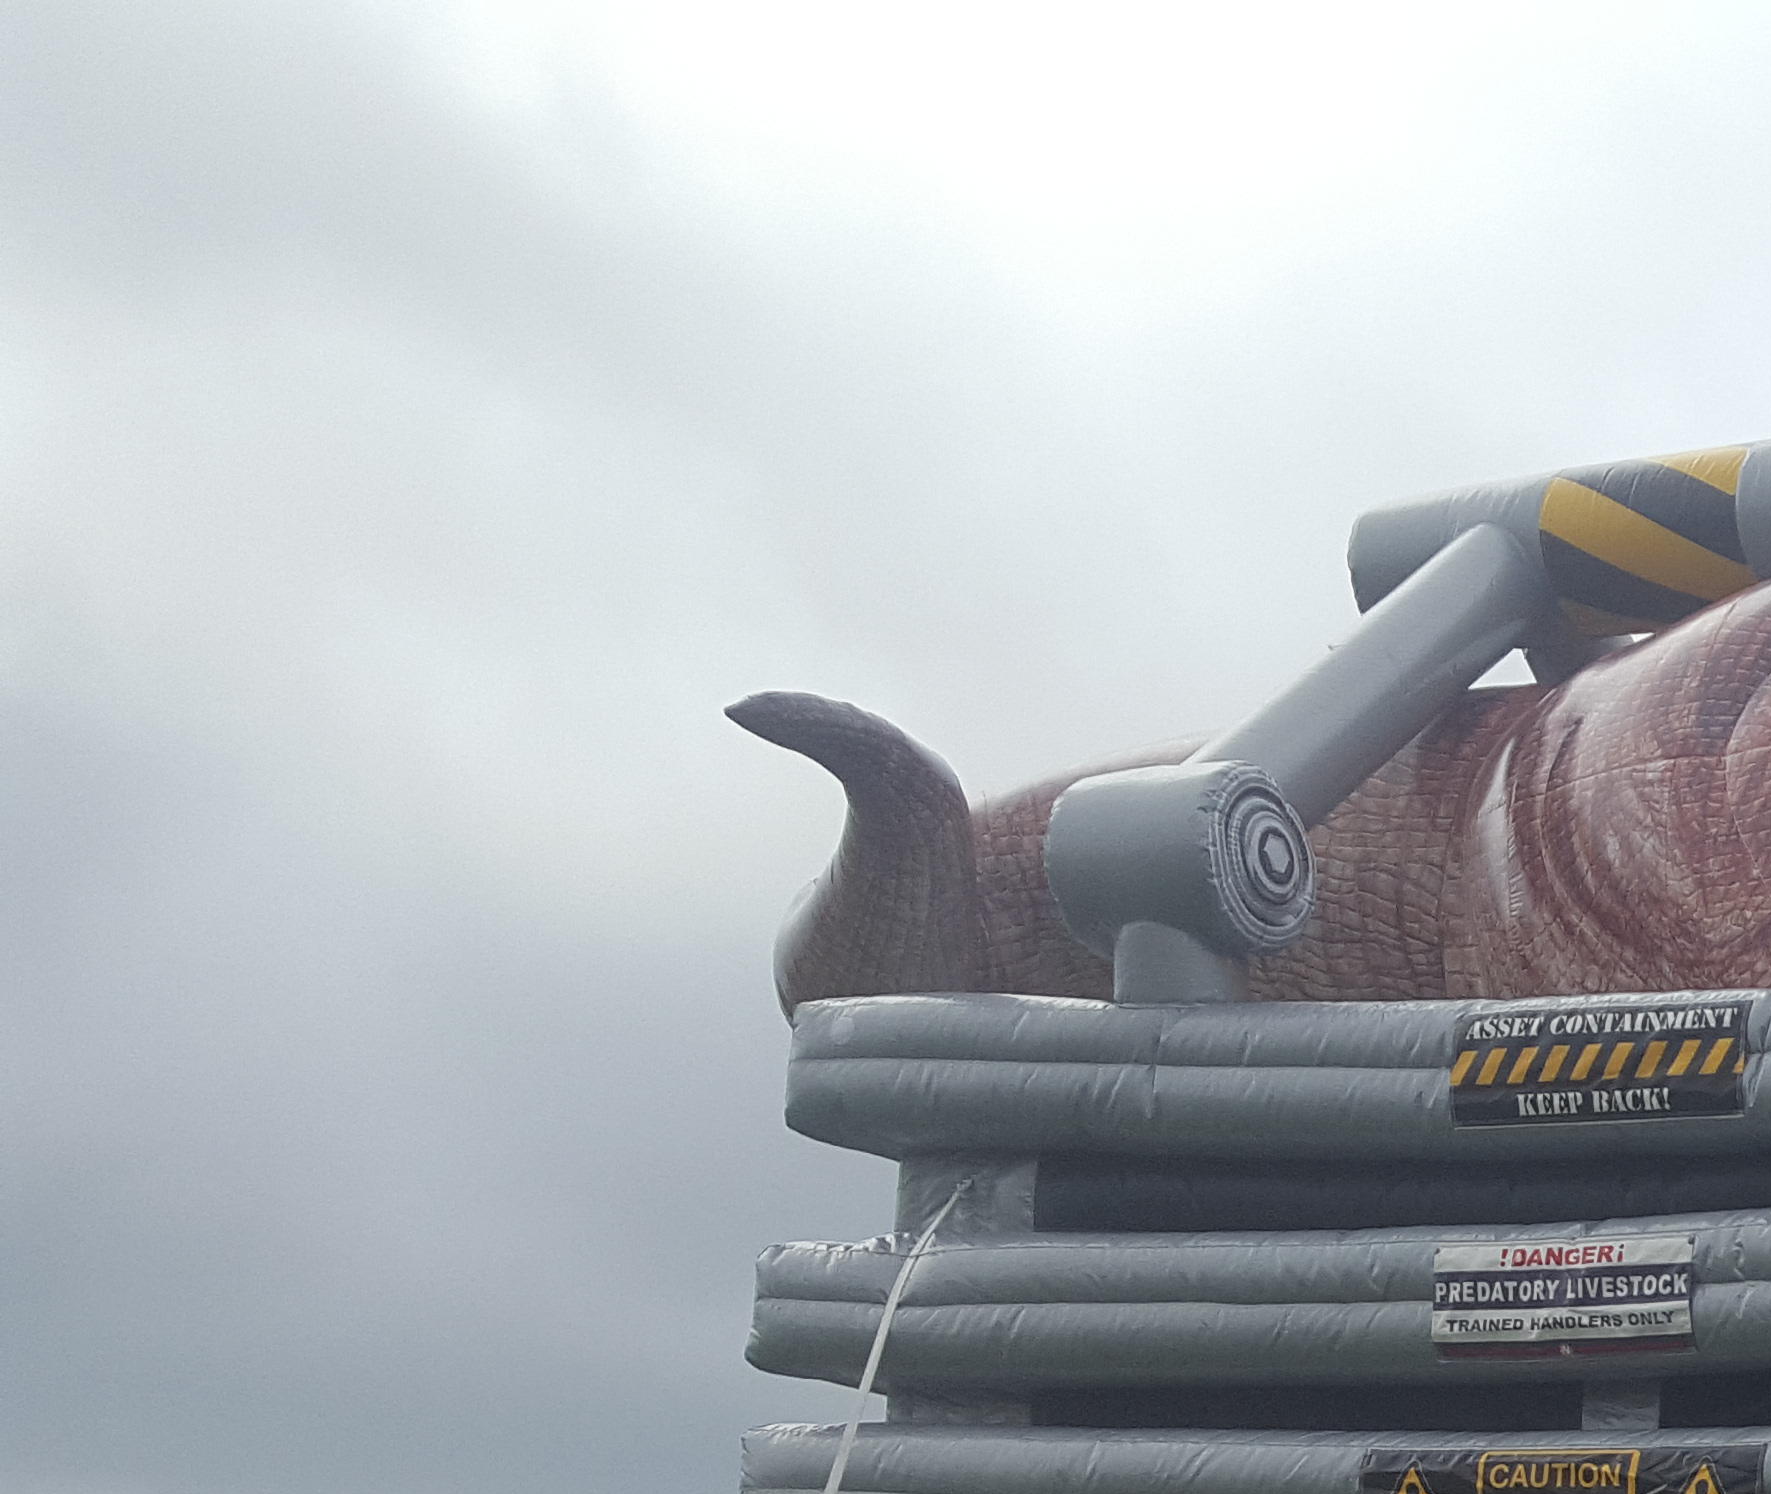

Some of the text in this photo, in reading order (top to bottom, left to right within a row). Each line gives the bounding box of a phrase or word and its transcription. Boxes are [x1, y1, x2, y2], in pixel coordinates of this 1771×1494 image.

[1465, 1008, 1739, 1041] ASSET CONTAINMENT
[1516, 1087, 1671, 1117] KEEP BACK!
[1435, 1273, 1688, 1303] PREDATORY LIVESTOCK
[1446, 1310, 1675, 1333] TRAINED HANDLERS ONLY
[1488, 1462, 1622, 1489] CAUTION
